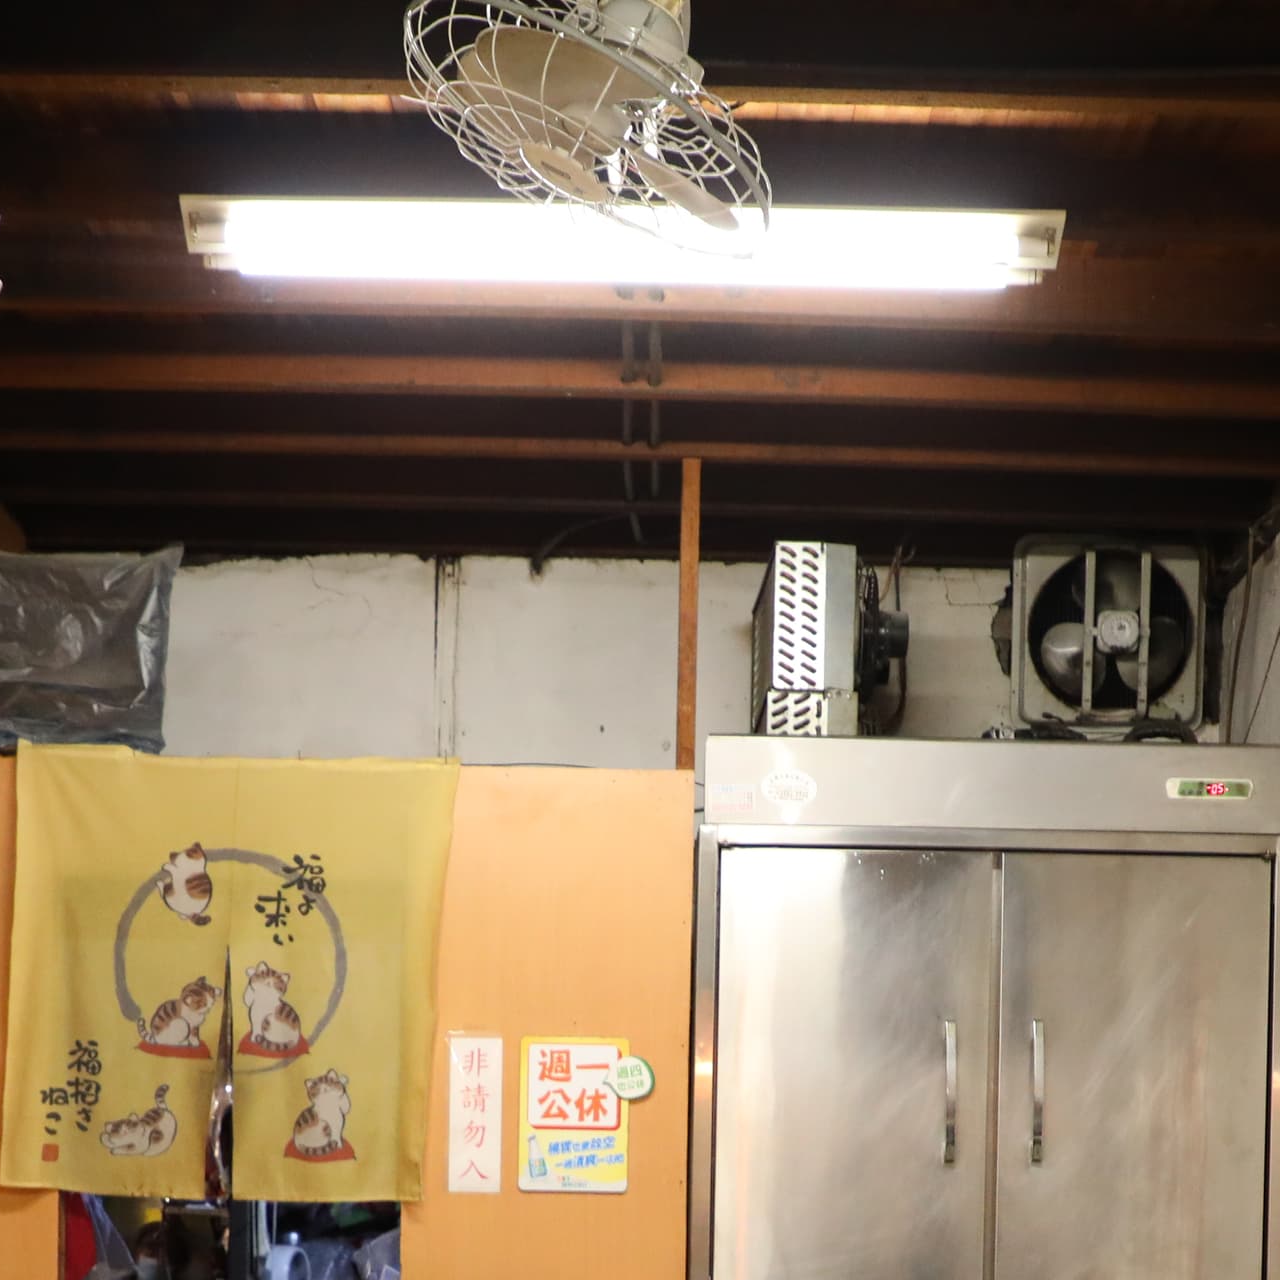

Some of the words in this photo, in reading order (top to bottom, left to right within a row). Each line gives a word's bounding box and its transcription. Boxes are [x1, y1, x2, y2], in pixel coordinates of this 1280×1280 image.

[538, 1049, 610, 1083] 週一
[461, 1047, 490, 1180] 非請勿入
[538, 1088, 608, 1122] 公休
